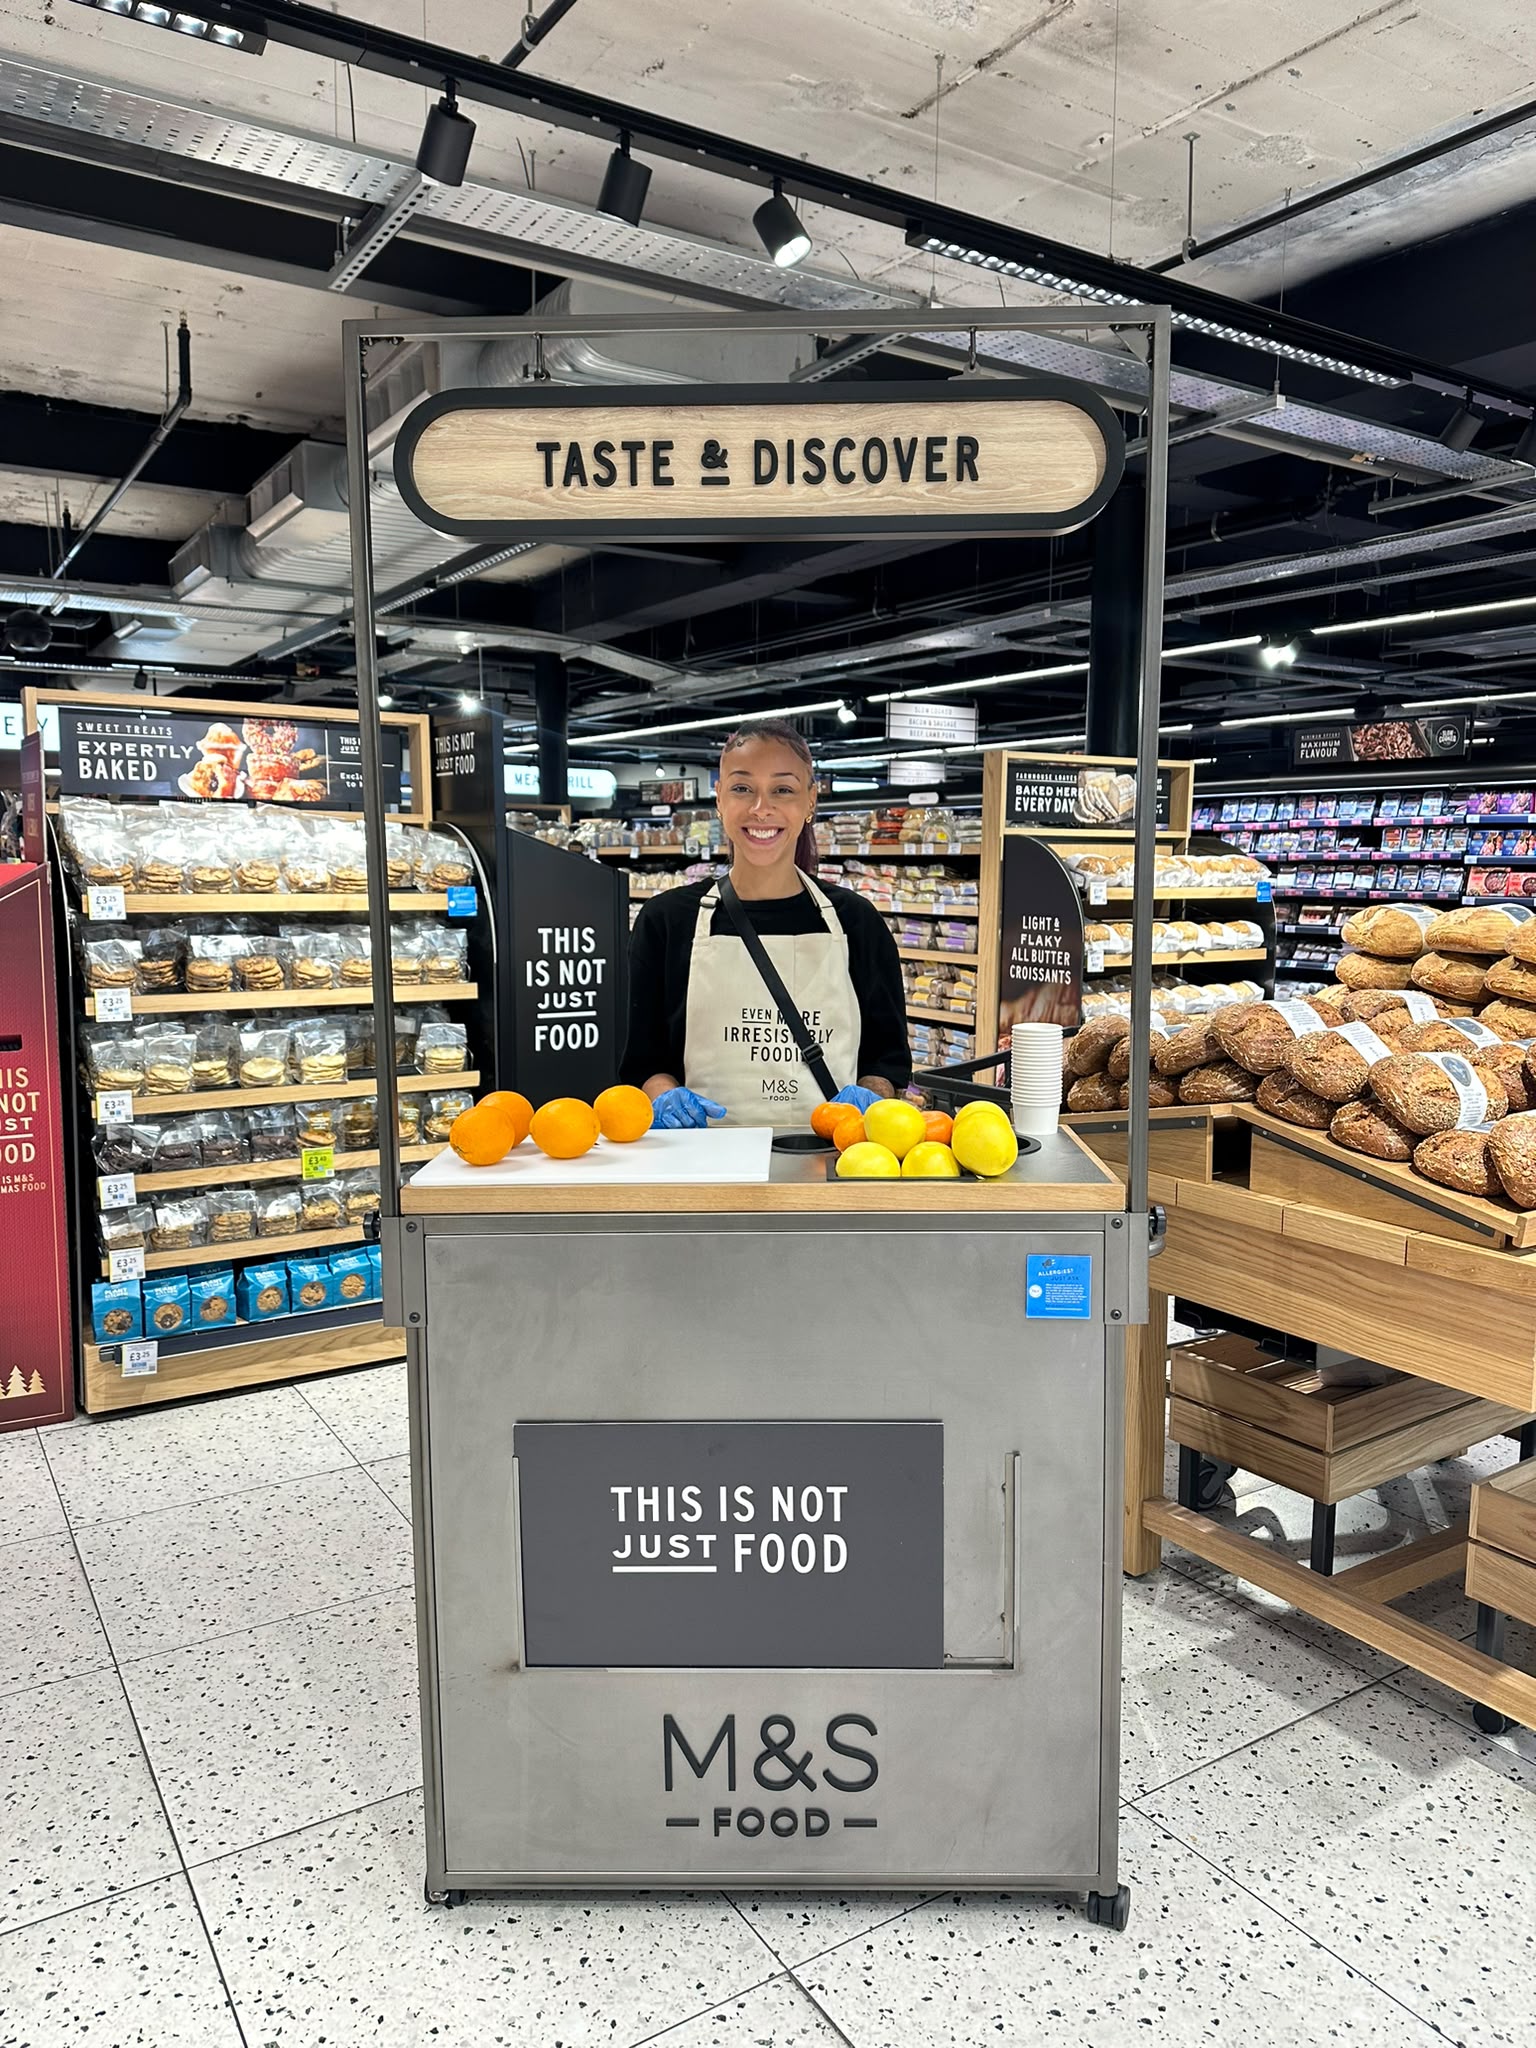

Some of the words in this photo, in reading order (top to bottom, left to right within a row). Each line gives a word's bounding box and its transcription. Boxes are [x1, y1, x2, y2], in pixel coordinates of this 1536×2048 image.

[536, 440, 675, 487] TASTE
[701, 439, 730, 485] &
[754, 436, 980, 485] DISCOVER
[76, 722, 119, 733] SWEET
[126, 725, 173, 736] TREATS
[77, 740, 194, 760] EXPERTLY
[340, 736, 357, 745] THIS
[435, 735, 451, 754] THIS
[451, 733, 460, 752] IS
[460, 731, 475, 751] NOT
[1300, 740, 1341, 749] MAXIMUM
[1300, 746, 1338, 759] FLAVOUR
[78, 757, 158, 782] BAKED
[436, 756, 454, 770] JUST
[455, 753, 475, 775] FOOD
[1016, 772, 1052, 780] FARMHOUSE
[1016, 784, 1054, 796] BAKED
[1015, 796, 1053, 813] EVERY
[1054, 797, 1076, 814] DAY
[1022, 915, 1052, 931] LIGHT
[1054, 917, 1060, 931] &
[537, 926, 597, 954] THIS
[1020, 933, 1062, 948] FLAKY
[1011, 947, 1030, 963] ALL
[1031, 949, 1071, 966] BUTTER
[526, 959, 551, 987] IS
[559, 958, 607, 986] NOT
[1009, 964, 1072, 985] CROISSANTS
[537, 990, 598, 1010] JUST
[742, 1008, 772, 1021] EVEN
[776, 1009, 822, 1026] MRE
[535, 1022, 600, 1052] FOOD
[0, 1067, 29, 1089] IS
[762, 1079, 799, 1094] M&S
[0, 1116, 33, 1132] ST
[0, 1142, 36, 1165] OD
[2, 1175, 12, 1184] IS
[14, 1173, 35, 1183] M&S
[22, 1181, 47, 1192] FOOD
[104, 1287, 128, 1296] PLANT
[610, 1485, 703, 1522] THIS
[719, 1485, 755, 1522] IS
[772, 1485, 848, 1522] NOT
[612, 1534, 717, 1559] JUST
[734, 1533, 848, 1574] FOOD
[664, 1713, 879, 1793] M&S
[713, 1806, 831, 1838] FOOD
